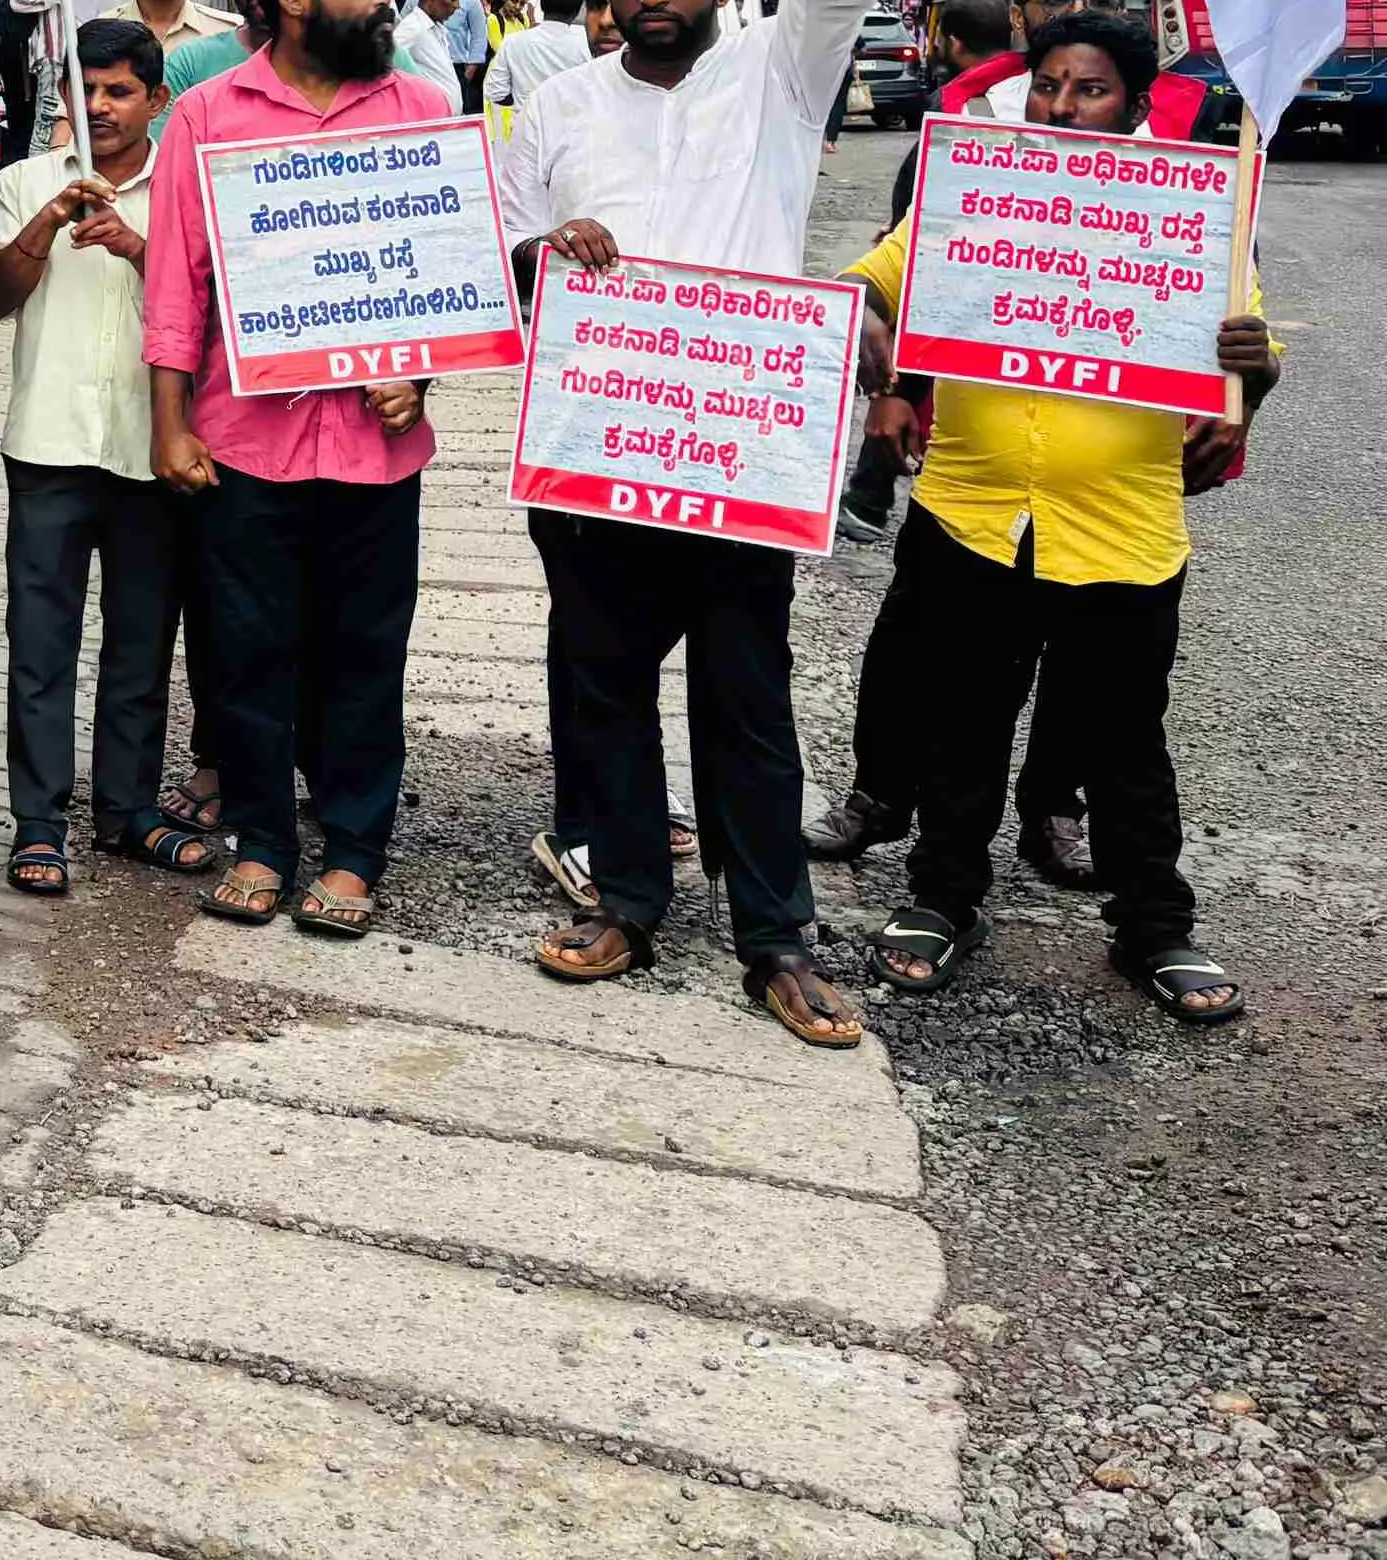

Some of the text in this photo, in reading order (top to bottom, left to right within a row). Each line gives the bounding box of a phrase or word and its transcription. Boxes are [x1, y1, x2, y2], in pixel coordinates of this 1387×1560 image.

[253, 140, 442, 185] ಗುಂಡಿಗಳಿಂದ ತುಂಬಿ
[1065, 149, 1229, 195] ಅಧಿಕಾರಿಗಳೇ
[249, 185, 462, 235] ಹೋಗಿರುವ ಕಂಕನಾಡಿ
[960, 188, 1207, 255] ಕಂಕನಾಡಿ ಮುಖ್ಯ ರಸ್ತೆ
[313, 237, 419, 285] ಮುಖ್ಯ ರಸ್ತೆ
[947, 236, 1205, 303] ಗುಂಡಿಗಳನ್ನು ಮುಚ್ಚಲು
[674, 282, 828, 328] ಅಧಿಕಾರಿಗಳೇ
[328, 343, 433, 379] DYFI
[573, 317, 808, 389] ಕಂಕನಾಡಿ ಮುಖ್ಯ ರಸ್ತೆ
[1000, 350, 1123, 394] DYFI
[560, 366, 806, 438] ಗುಂಡಿಗಳನ್ನು ಮುಚ್ಚಲು
[610, 483, 726, 530] DYFI
